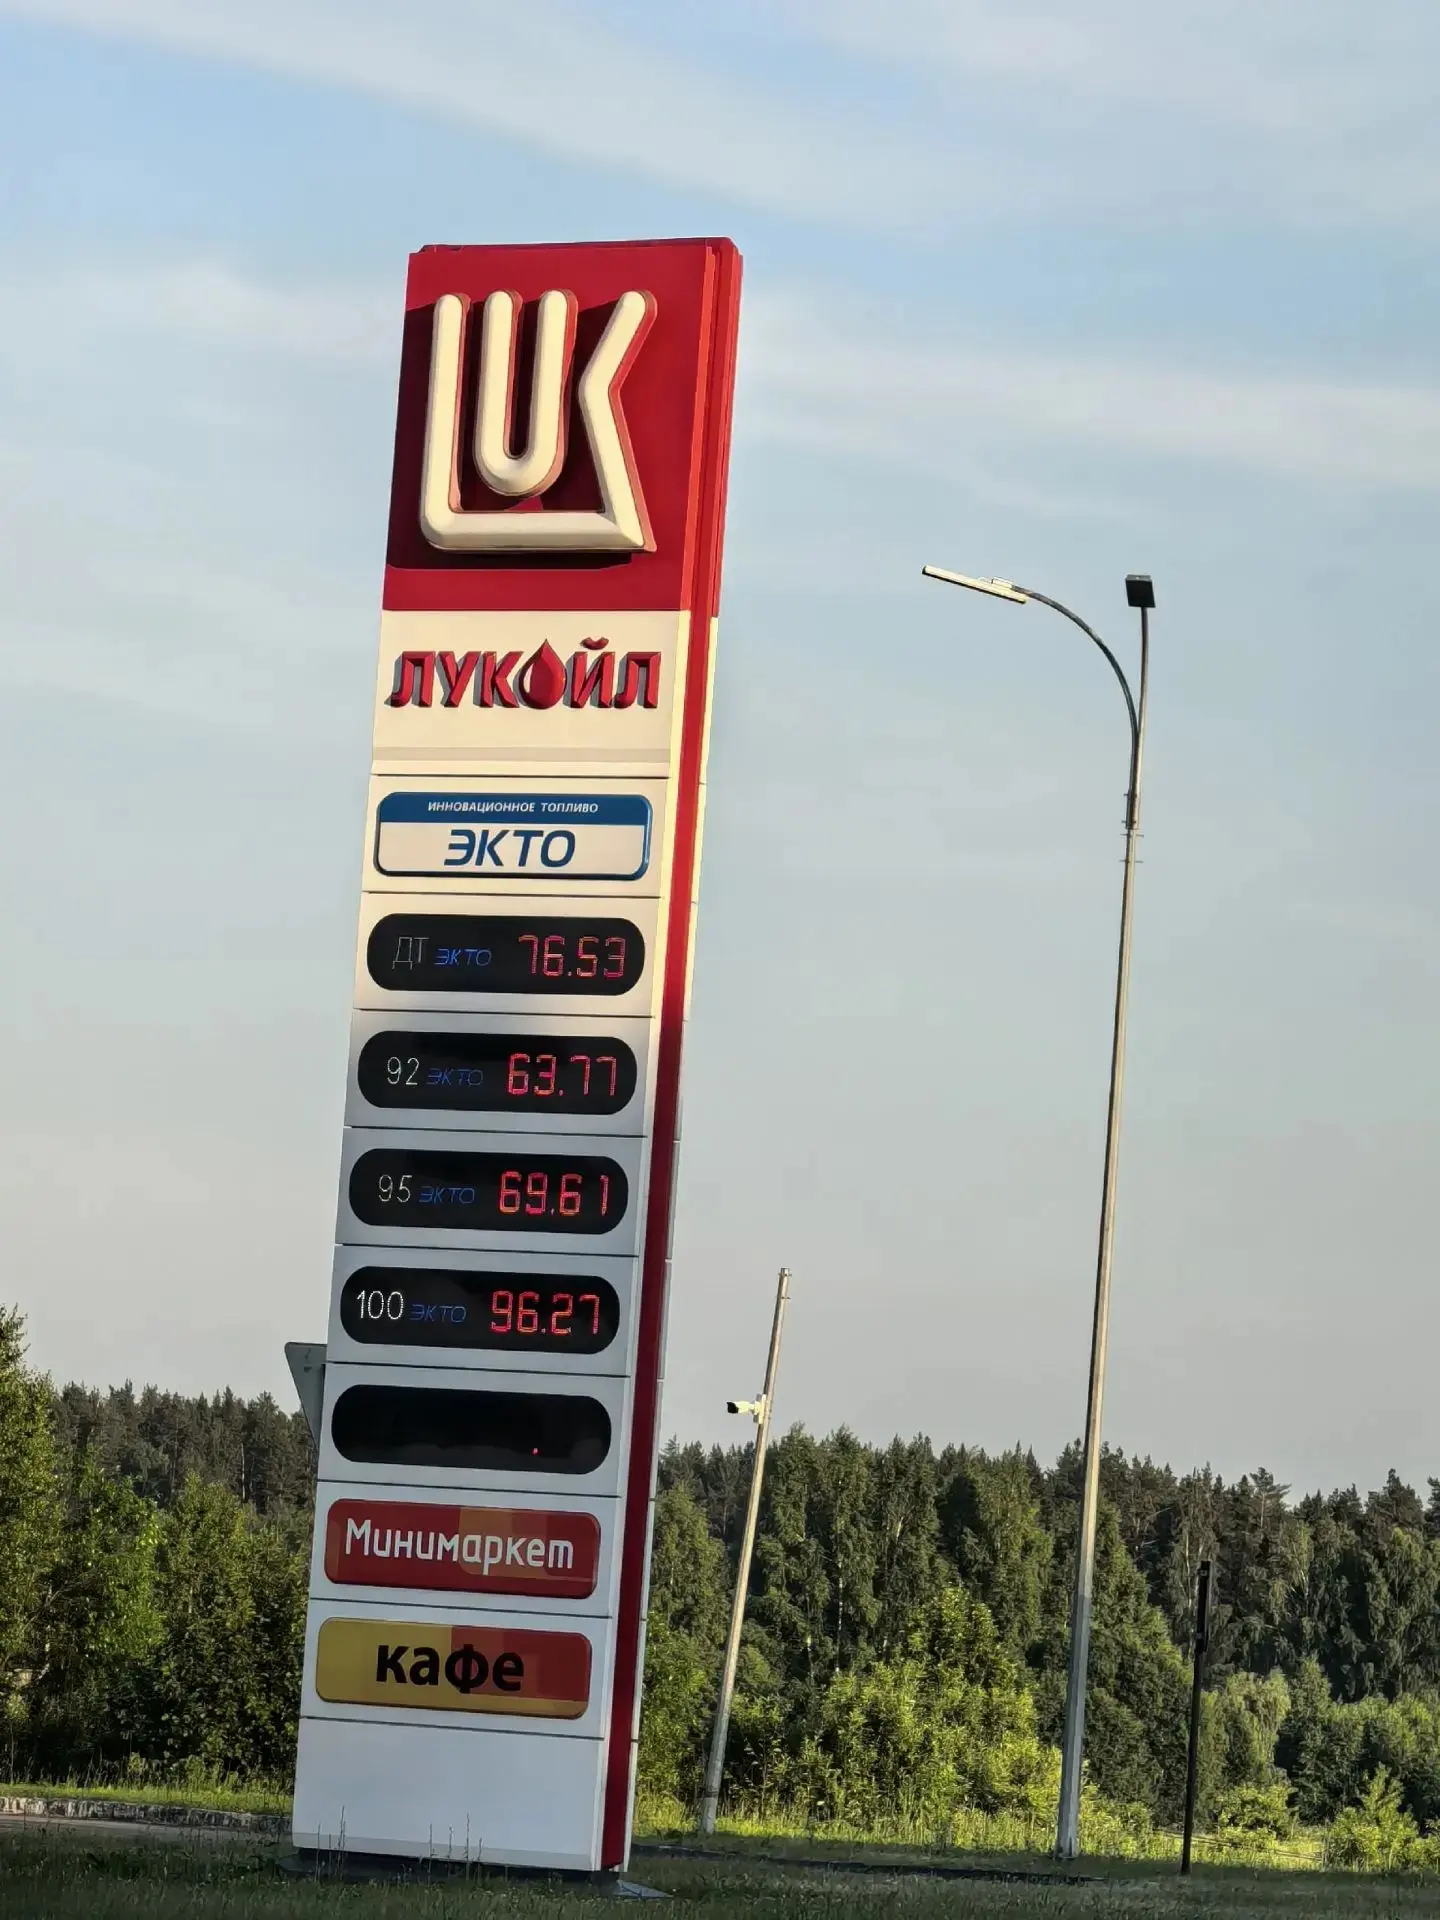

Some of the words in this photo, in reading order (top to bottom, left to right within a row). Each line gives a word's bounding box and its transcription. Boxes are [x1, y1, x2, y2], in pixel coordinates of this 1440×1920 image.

[391, 638, 661, 709] ЛУКОЙЛ
[427, 801, 536, 815] ИННОВАЦИОННОЕ
[541, 802, 599, 814] ТОПЛИВО
[444, 829, 576, 867] ЭКТО
[392, 936, 429, 970] ДТ
[433, 947, 492, 967] ЭКТО
[518, 935, 628, 977] 76.53
[386, 1056, 420, 1086] 92
[426, 1067, 484, 1086] ЭКТО
[506, 1053, 618, 1096] 63.77
[378, 1174, 413, 1203] 95
[418, 1186, 476, 1205] ЭКТО
[498, 1171, 610, 1216] 69.61
[356, 1289, 405, 1320] 100
[409, 1303, 468, 1323] ЭКТО
[490, 1290, 601, 1335] 96.27
[345, 1517, 574, 1575] Минимаркет
